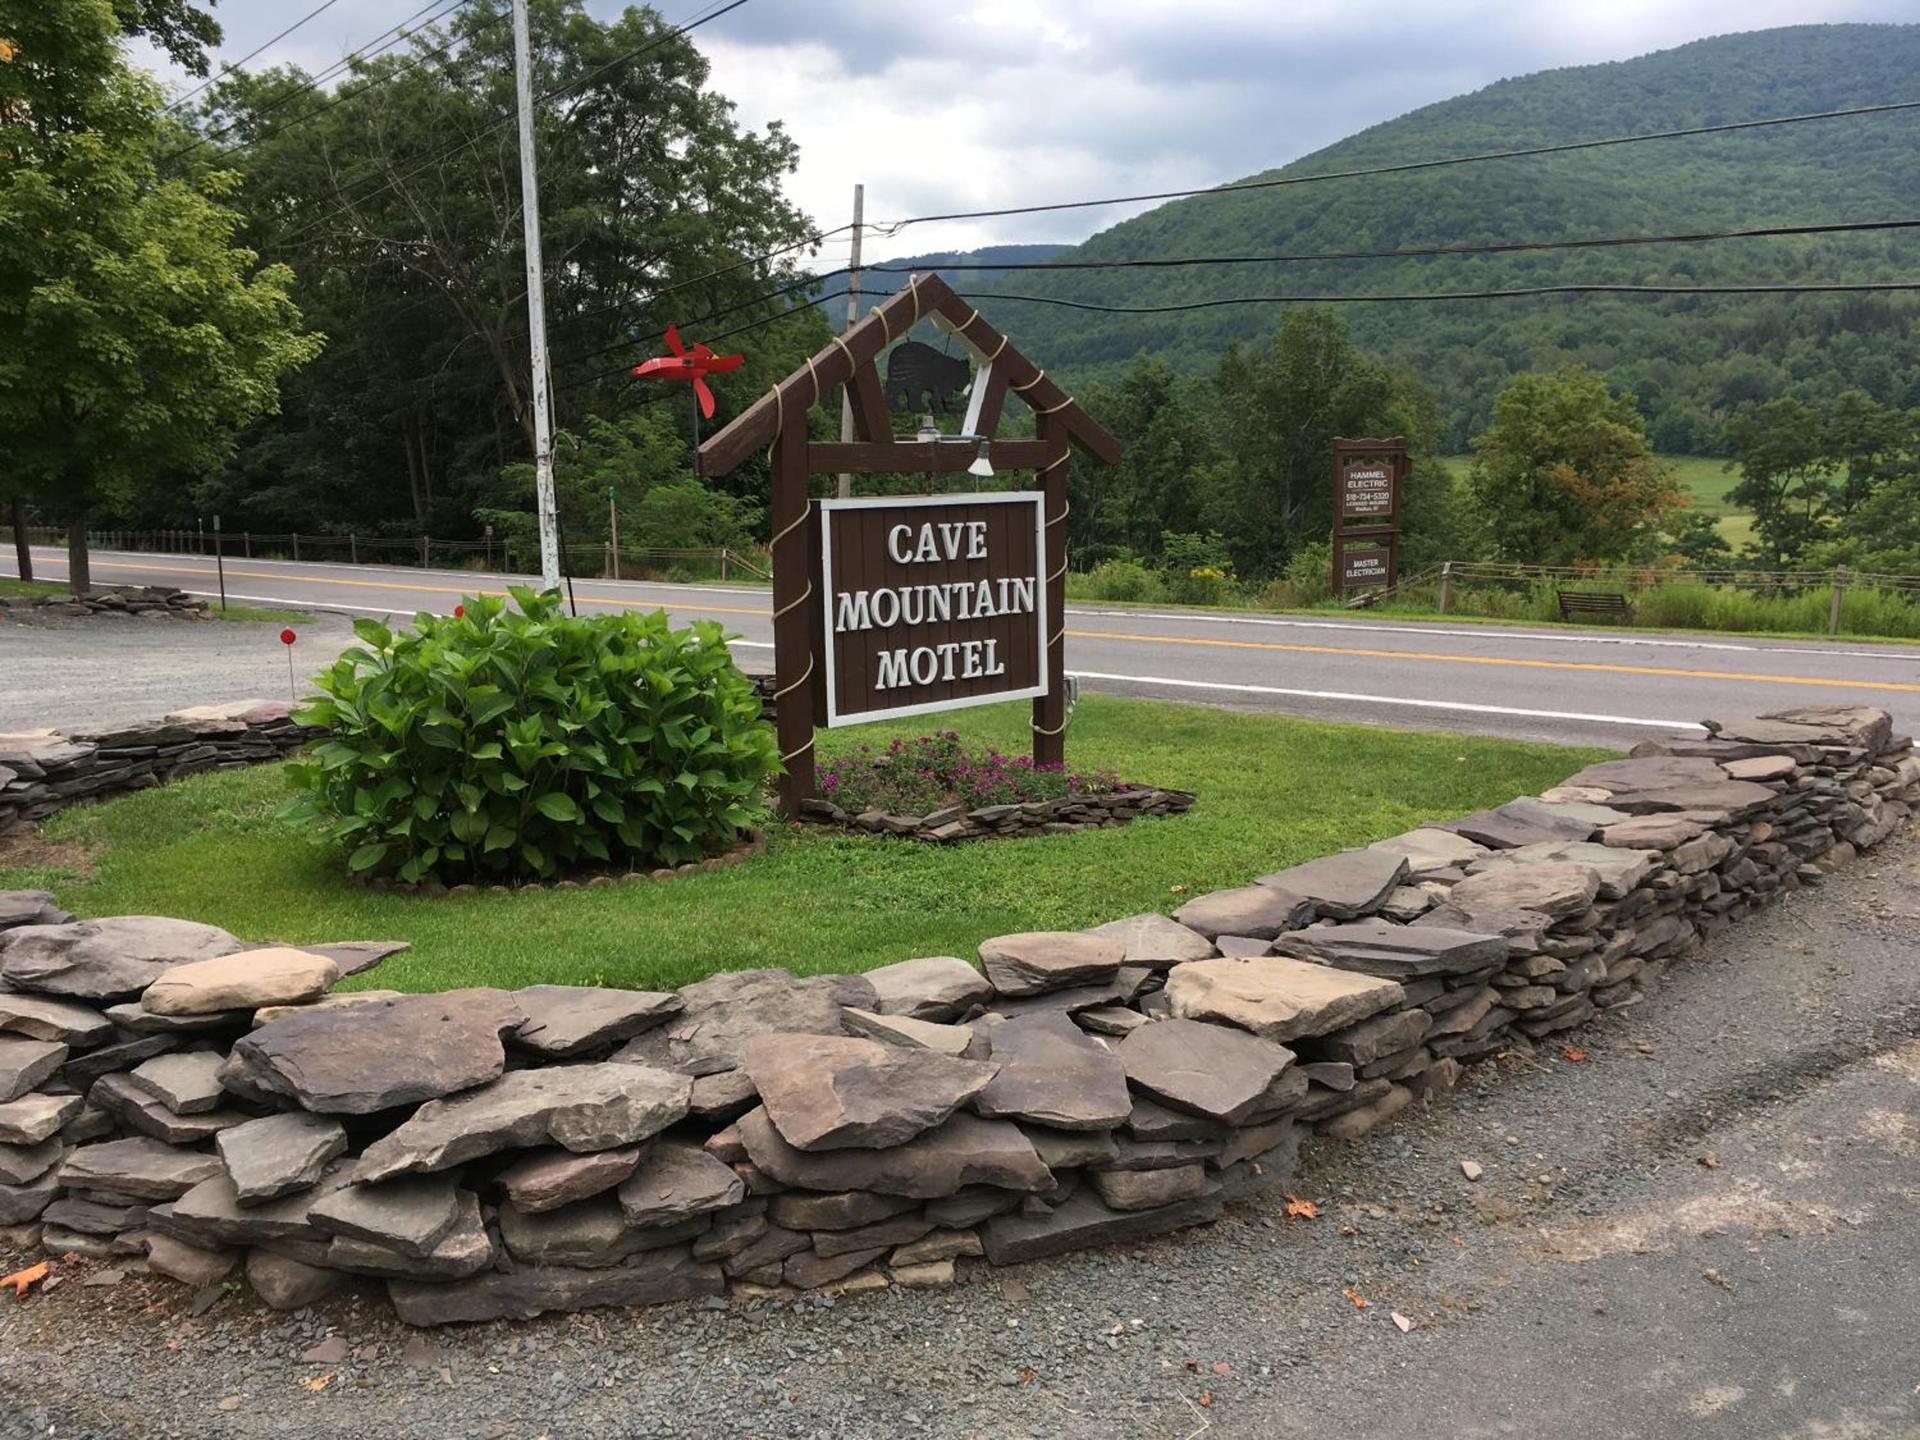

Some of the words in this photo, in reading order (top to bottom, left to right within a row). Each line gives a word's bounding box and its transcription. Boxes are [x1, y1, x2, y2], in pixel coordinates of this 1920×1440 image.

[1350, 471, 1386, 479] HAMMEL
[1347, 480, 1388, 488] ELECTRIC
[888, 522, 988, 564] CAVE
[1353, 559, 1379, 568] MASTER
[1346, 566, 1386, 578] ELECTRICIAN
[835, 577, 1036, 632] MOUNTAIN
[874, 639, 1005, 690] MOTEL
